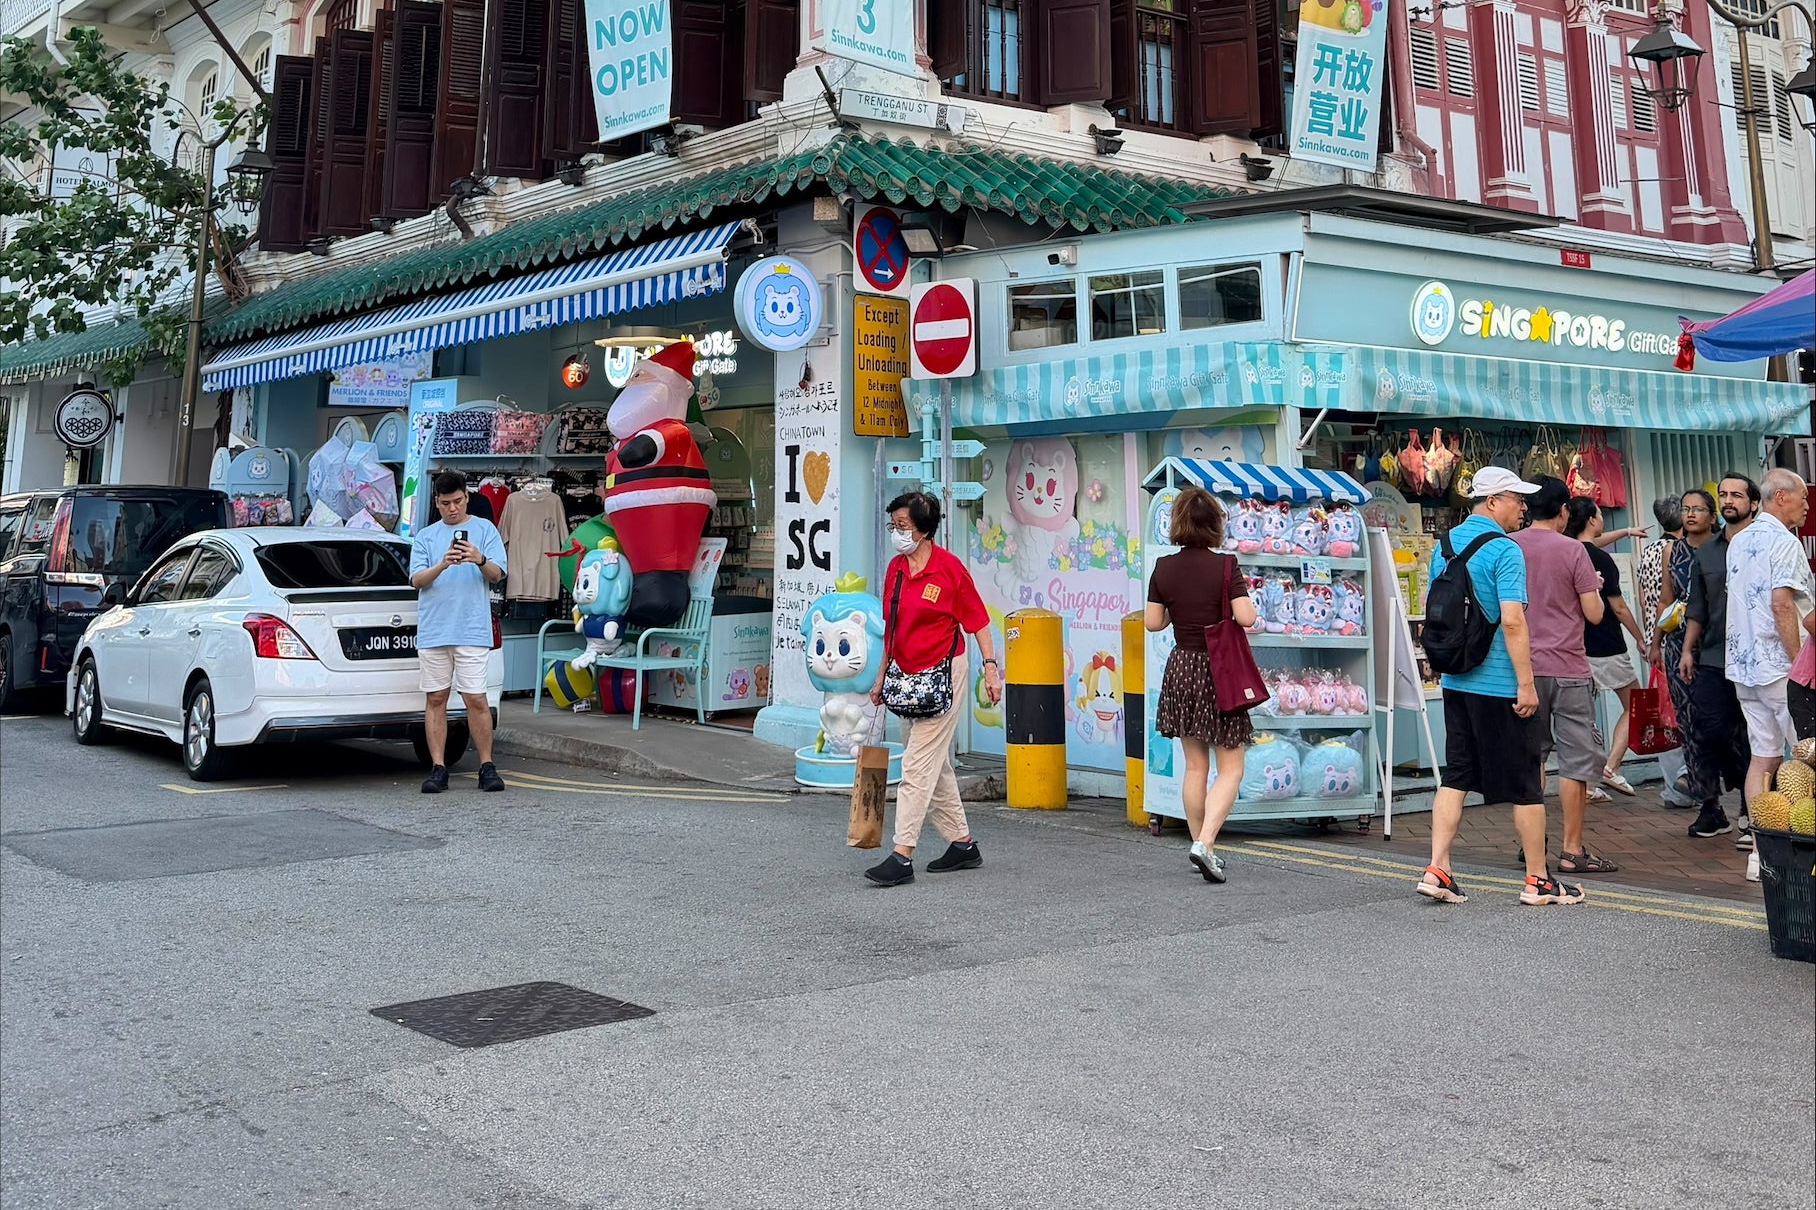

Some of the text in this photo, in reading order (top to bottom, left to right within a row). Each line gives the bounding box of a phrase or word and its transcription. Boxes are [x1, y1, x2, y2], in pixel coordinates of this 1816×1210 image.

[594, 0, 666, 50] NOW
[831, 29, 908, 63] Sinnkawa.com
[595, 47, 668, 96] OPEN
[1311, 42, 1375, 95] 开放
[858, 93, 929, 114] TRENGGANU ST
[604, 103, 666, 129] Sinnkawa.com
[1307, 90, 1370, 142] 营业
[1298, 136, 1370, 160] Sinnkawa.com
[865, 305, 899, 328] Except
[857, 328, 896, 353] Loading
[1628, 331, 1656, 355] Gift
[1657, 334, 1681, 357] Ga
[711, 358, 737, 375] Gate
[858, 353, 907, 378] Unloading
[568, 372, 583, 383] 60
[868, 379, 897, 392] Between
[1083, 378, 1122, 397] Sinnkawa
[1147, 370, 1230, 392] Sinnkawa Gift Gate
[1397, 373, 1438, 394] Sinnkawa
[332, 388, 367, 396] MERLION
[376, 389, 408, 397] FRIENDS
[862, 396, 869, 408] 12
[860, 414, 865, 425] &
[869, 414, 886, 427] 11am
[779, 425, 825, 441] CHINATOWN
[784, 444, 800, 503] I
[786, 518, 832, 572] SG
[734, 625, 769, 638] Sinnkawa
[776, 632, 785, 649] je
[365, 636, 390, 651] JQN
